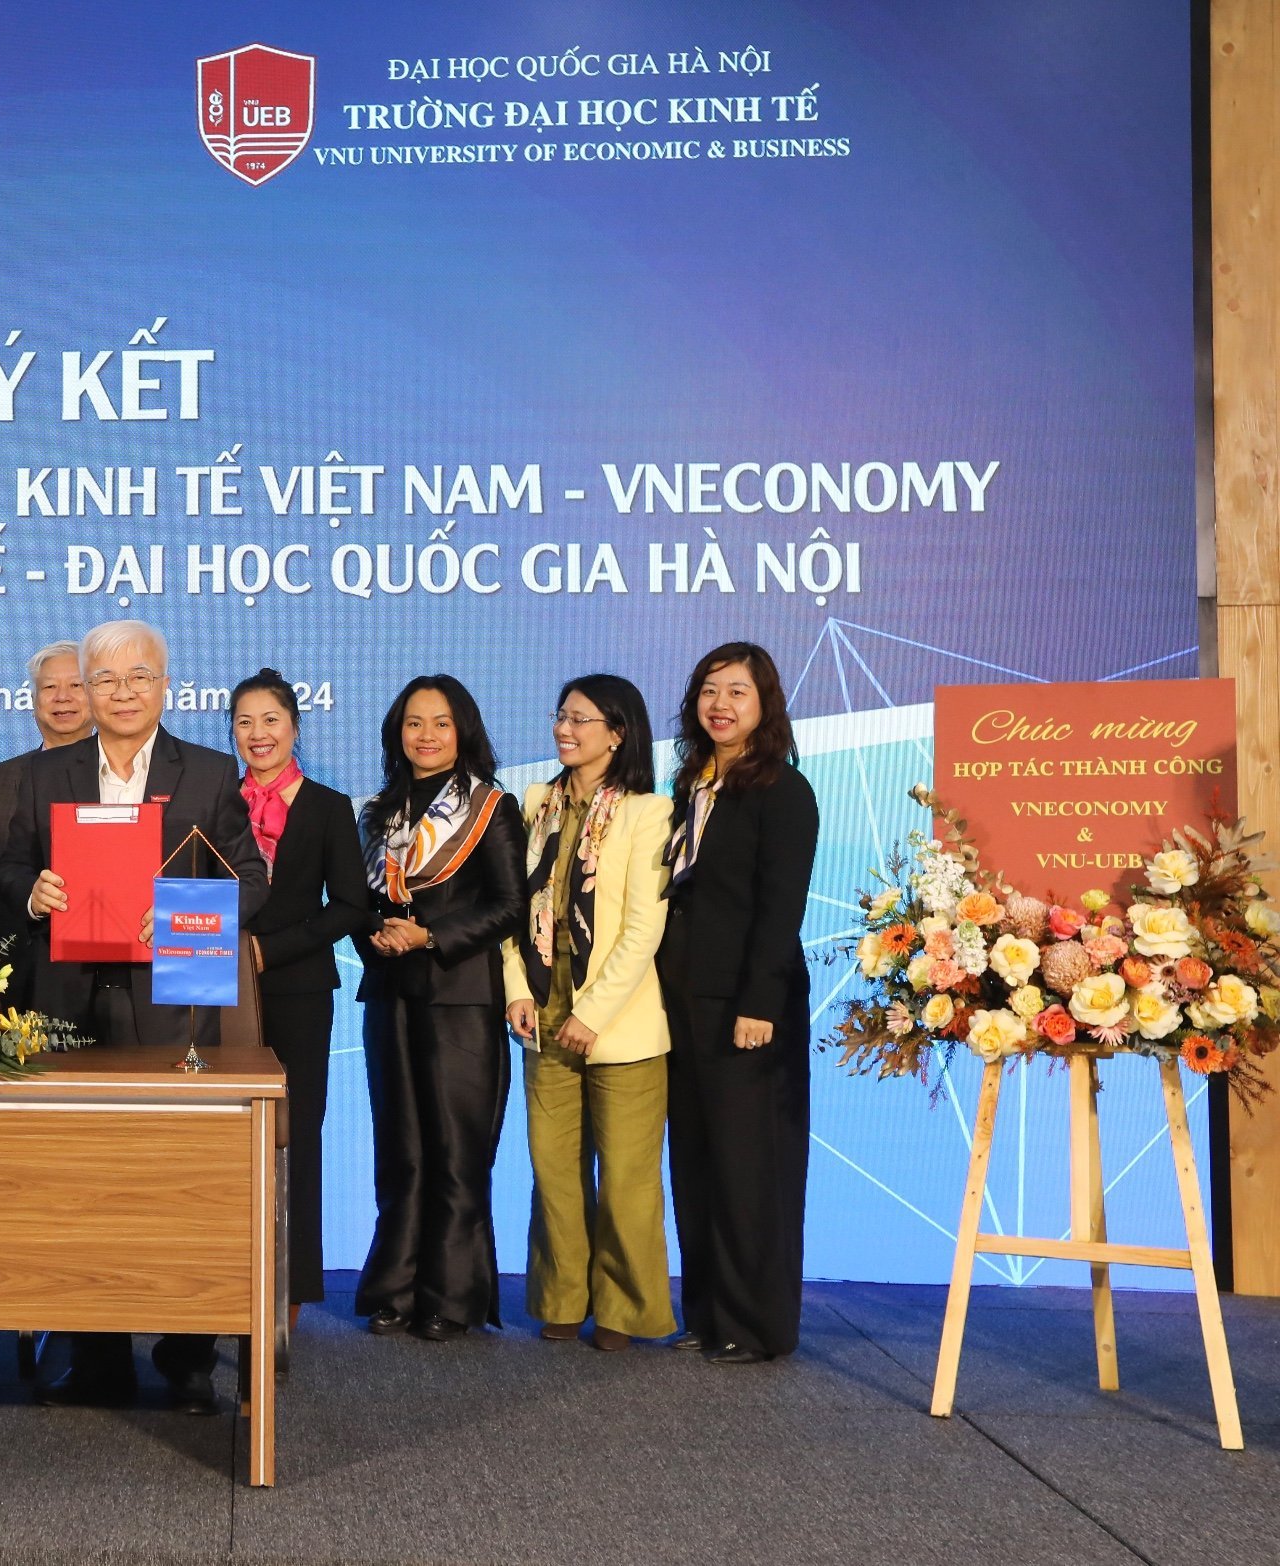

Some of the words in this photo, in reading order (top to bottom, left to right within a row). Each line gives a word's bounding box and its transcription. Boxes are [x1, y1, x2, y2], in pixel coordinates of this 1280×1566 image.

[388, 58, 441, 85] ĐẠI
[448, 56, 509, 83] HỌC
[516, 45, 601, 82] QUỐC
[607, 53, 660, 76] GIA
[667, 46, 711, 74] HÀ
[718, 44, 772, 77] NỘI
[243, 106, 291, 126] UEB
[343, 96, 495, 131] TRƯỜNG
[504, 98, 569, 134] ĐẠI
[578, 97, 658, 132] HỌC
[667, 96, 762, 124] KINH
[771, 82, 821, 122] TẾ
[246, 162, 266, 170] 1974
[313, 144, 364, 166] VNU
[371, 143, 518, 165] UNIVERSITY
[523, 142, 558, 162] OF
[563, 140, 701, 161] ECONOMIC
[707, 140, 726, 159] &
[732, 137, 851, 158] BUSINESS
[62, 316, 214, 421] KẾT
[16, 466, 156, 516] KINH
[175, 444, 243, 516] TẾ
[259, 450, 385, 528] VIỆT
[404, 464, 543, 516] NAM
[564, 490, 585, 499] -
[601, 461, 1000, 514] VNECONOMY
[25, 573, 46, 581] -
[63, 544, 163, 607] ĐẠI
[187, 543, 313, 607] HỌC
[330, 519, 501, 601] QUỐC
[520, 541, 630, 594] GIA
[648, 525, 734, 595] HÀ
[754, 525, 862, 607] NỘI
[293, 681, 335, 711] 24
[971, 709, 1074, 745] Chúc
[1089, 715, 1199, 748] mừng
[953, 761, 1003, 781] HỢP
[1008, 757, 1055, 777] TÁC
[1060, 756, 1148, 777] THÀNH
[1153, 755, 1224, 775] CÔNG
[1010, 800, 1169, 817] VNECONOMY
[1076, 826, 1095, 843] &
[1036, 853, 1144, 869] VNU-UEB
[175, 915, 203, 925] Kinh
[206, 914, 218, 926] tế
